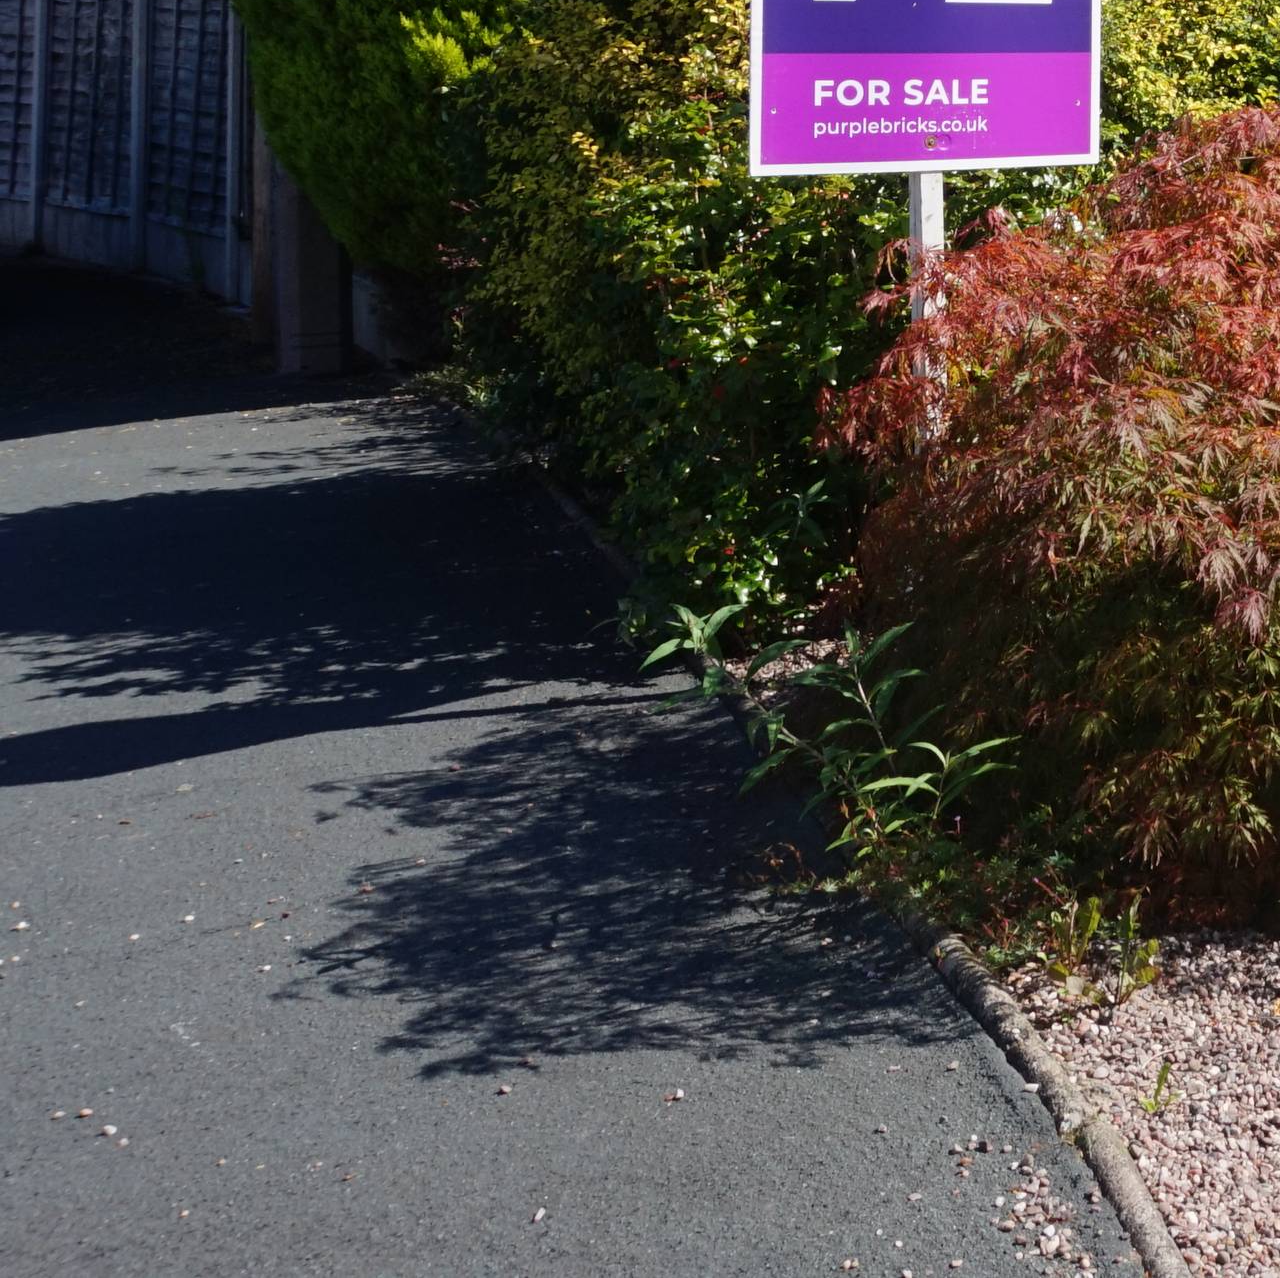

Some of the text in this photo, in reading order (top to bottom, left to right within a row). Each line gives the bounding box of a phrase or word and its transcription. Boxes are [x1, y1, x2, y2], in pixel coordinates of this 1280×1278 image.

[813, 78, 989, 107] FOR SALE
[813, 115, 988, 138] purplebricks.co.uk
